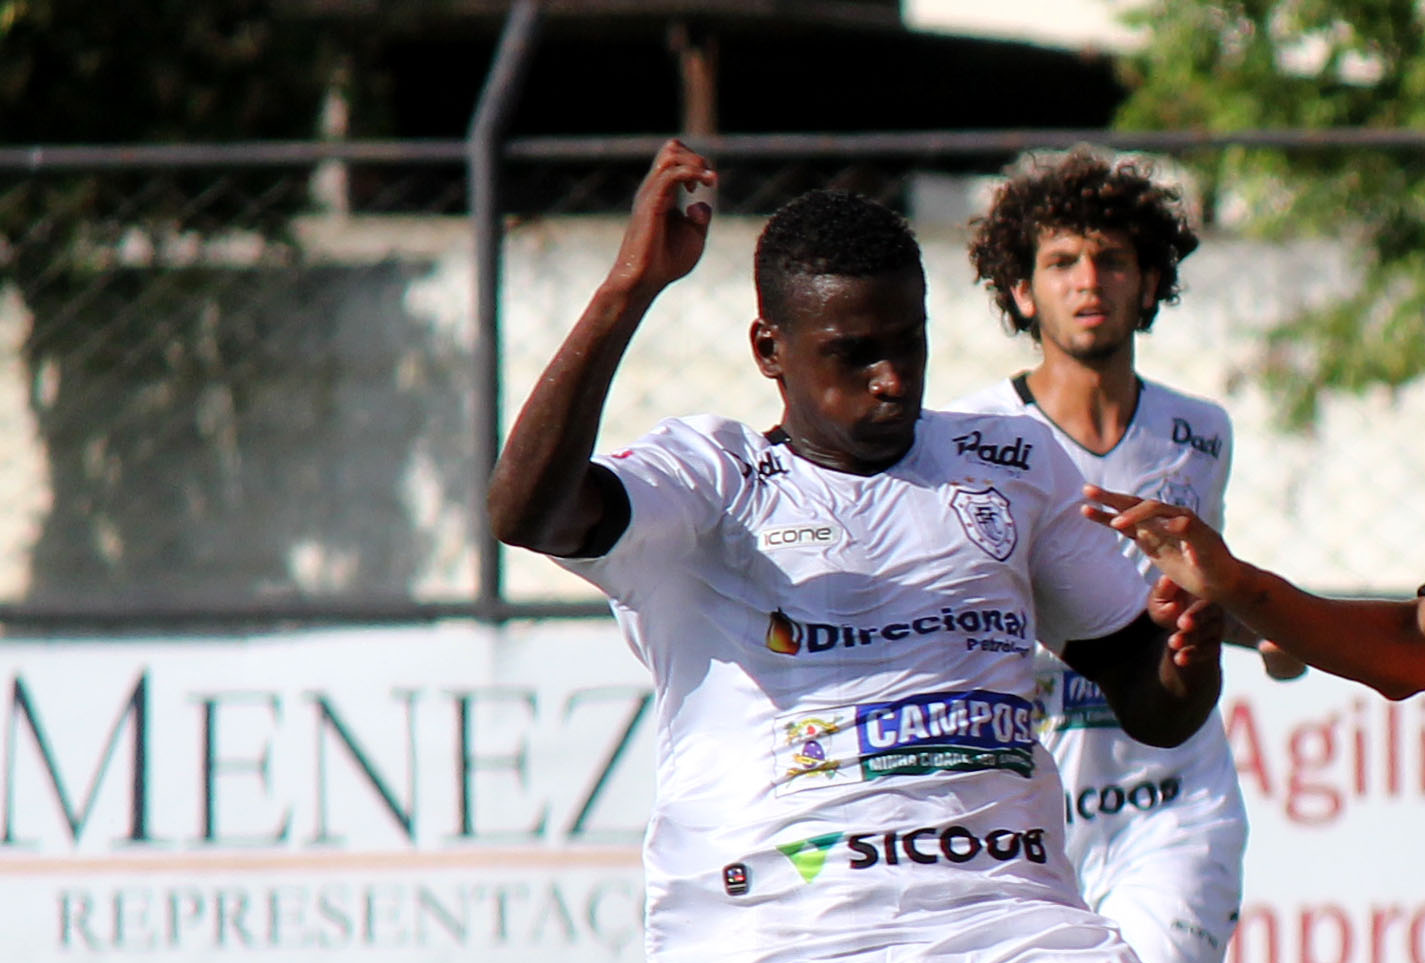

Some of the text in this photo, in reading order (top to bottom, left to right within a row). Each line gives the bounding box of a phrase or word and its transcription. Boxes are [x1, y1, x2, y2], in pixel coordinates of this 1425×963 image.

[764, 527, 832, 546] icone
[866, 699, 1033, 747] CAMPOS
[0, 665, 652, 850] MENEZ
[849, 826, 1046, 869] SICOOB
[58, 880, 646, 955] REPRESENTAÇ
